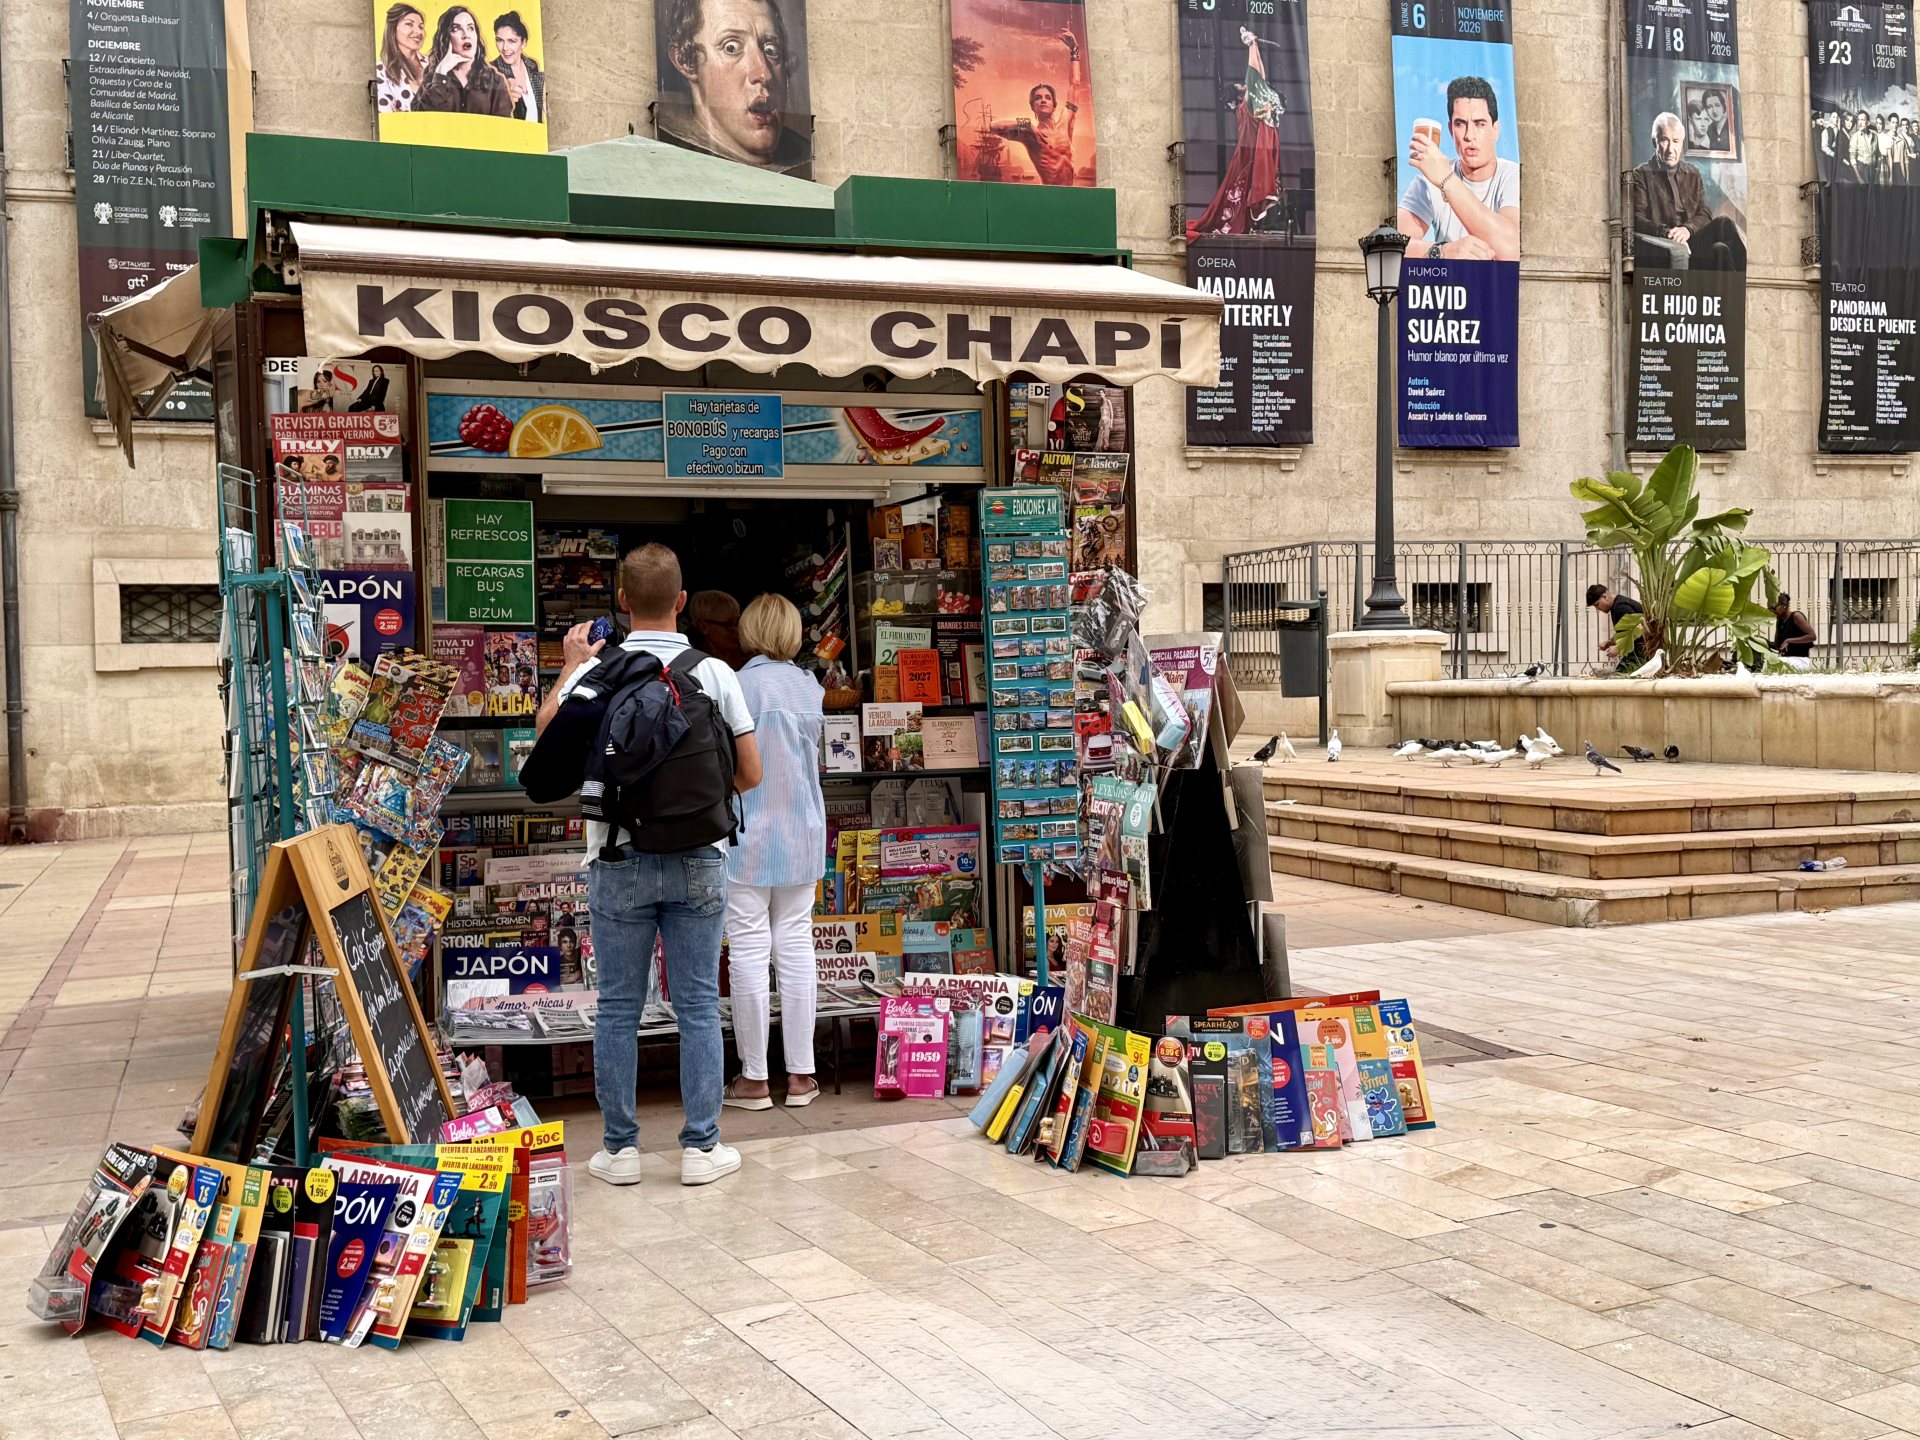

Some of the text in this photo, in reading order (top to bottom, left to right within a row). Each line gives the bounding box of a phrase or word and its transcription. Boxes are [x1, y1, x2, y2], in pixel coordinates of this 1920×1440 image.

[1250, 1, 1274, 14] 2026
[100, 12, 181, 25] Orquesta Balthasar
[1413, 4, 1426, 29] 6
[1458, 7, 1504, 22] NOVIEMBRE
[88, 23, 129, 32] Neumann
[1458, 21, 1481, 33] 2026
[1645, 25, 1655, 49] 7
[1672, 27, 1684, 52] 8
[1711, 31, 1728, 44] NOV.
[88, 40, 141, 51] DICIEMBRE
[1711, 44, 1731, 57] 2026
[1875, 44, 1908, 57] OCTUBRE
[1829, 40, 1852, 65] 23
[89, 54, 156, 66] 12 Concierto
[1876, 57, 1896, 69] 2026
[89, 65, 191, 80] Extraordinario de Navidad,
[89, 76, 173, 88] Orquesta Coro de la
[89, 88, 147, 99] Comunidad de
[121, 101, 132, 109] de
[133, 101, 155, 111] Santa
[90, 111, 134, 122] de Alicante
[92, 124, 103, 133] 14
[182, 129, 216, 139] Soprano
[91, 135, 116, 145] Olivia
[147, 138, 171, 148] Piano
[92, 150, 103, 159] 21
[111, 162, 121, 170] de
[122, 162, 149, 172] Pianos
[149, 165, 154, 173] y
[155, 164, 193, 174] Percusión
[93, 175, 105, 184] 28
[176, 179, 191, 188] con
[192, 178, 216, 189] Piano
[1197, 256, 1237, 268] ÓPERA
[1408, 266, 1448, 278] HUMOR
[1197, 276, 1275, 300] MADAMA
[1643, 276, 1683, 287] TEATRO
[1831, 283, 1867, 294] TEATRO
[1408, 284, 1467, 310] DAVID
[1642, 294, 1722, 316] EL HIJO DE
[1830, 300, 1888, 317] PANORAMA
[1224, 304, 1293, 327] TTERFLY
[356, 284, 1188, 370] KIOSCO CHAPÍ
[1408, 312, 1481, 344] SUÁREZ
[1641, 317, 1727, 344] LA CÓMICA
[1830, 316, 1917, 335] DESDE EL PUENTE
[1408, 350, 1509, 365] Humor blanco por última vez
[1408, 388, 1446, 397] David Suárez
[689, 400, 760, 416] Hay tarjetas de
[1408, 401, 1440, 410] Producción
[274, 415, 325, 430] REVISTA
[328, 416, 372, 429] GRATIS
[343, 431, 375, 440] VERANO
[667, 418, 780, 442] BONOBÚS y recargas
[281, 439, 341, 453] muy
[346, 446, 395, 459] muy
[702, 445, 747, 460] Pago con
[686, 462, 765, 476] efectivo o bizum
[1013, 499, 1045, 516] EDICIONES
[1047, 500, 1058, 515] AM
[476, 514, 503, 525] HAY
[451, 530, 529, 542] REFRESCOS
[456, 566, 525, 579] RECARGAS
[324, 575, 402, 601] APÓN
[477, 581, 505, 592] BUS
[469, 608, 513, 619] BIZUM
[1173, 650, 1199, 660] PASARELA
[908, 671, 931, 682] 2027
[867, 711, 892, 719] VENCER
[446, 916, 531, 929] HISTORIA CRIMEN
[455, 951, 549, 976] JAPÓN
[902, 986, 937, 997] CEPILLO
[565, 999, 574, 1011] y
[886, 999, 916, 1015] Barbie
[1193, 1020, 1239, 1030] SPEARHEAD
[911, 1051, 941, 1063] 1959
[1363, 1073, 1389, 1091] STITCH
[440, 1145, 509, 1155] OFERTA DE LANZAMIENTO
[441, 1160, 503, 1173] OFERTA DE LANZAMIENTO
